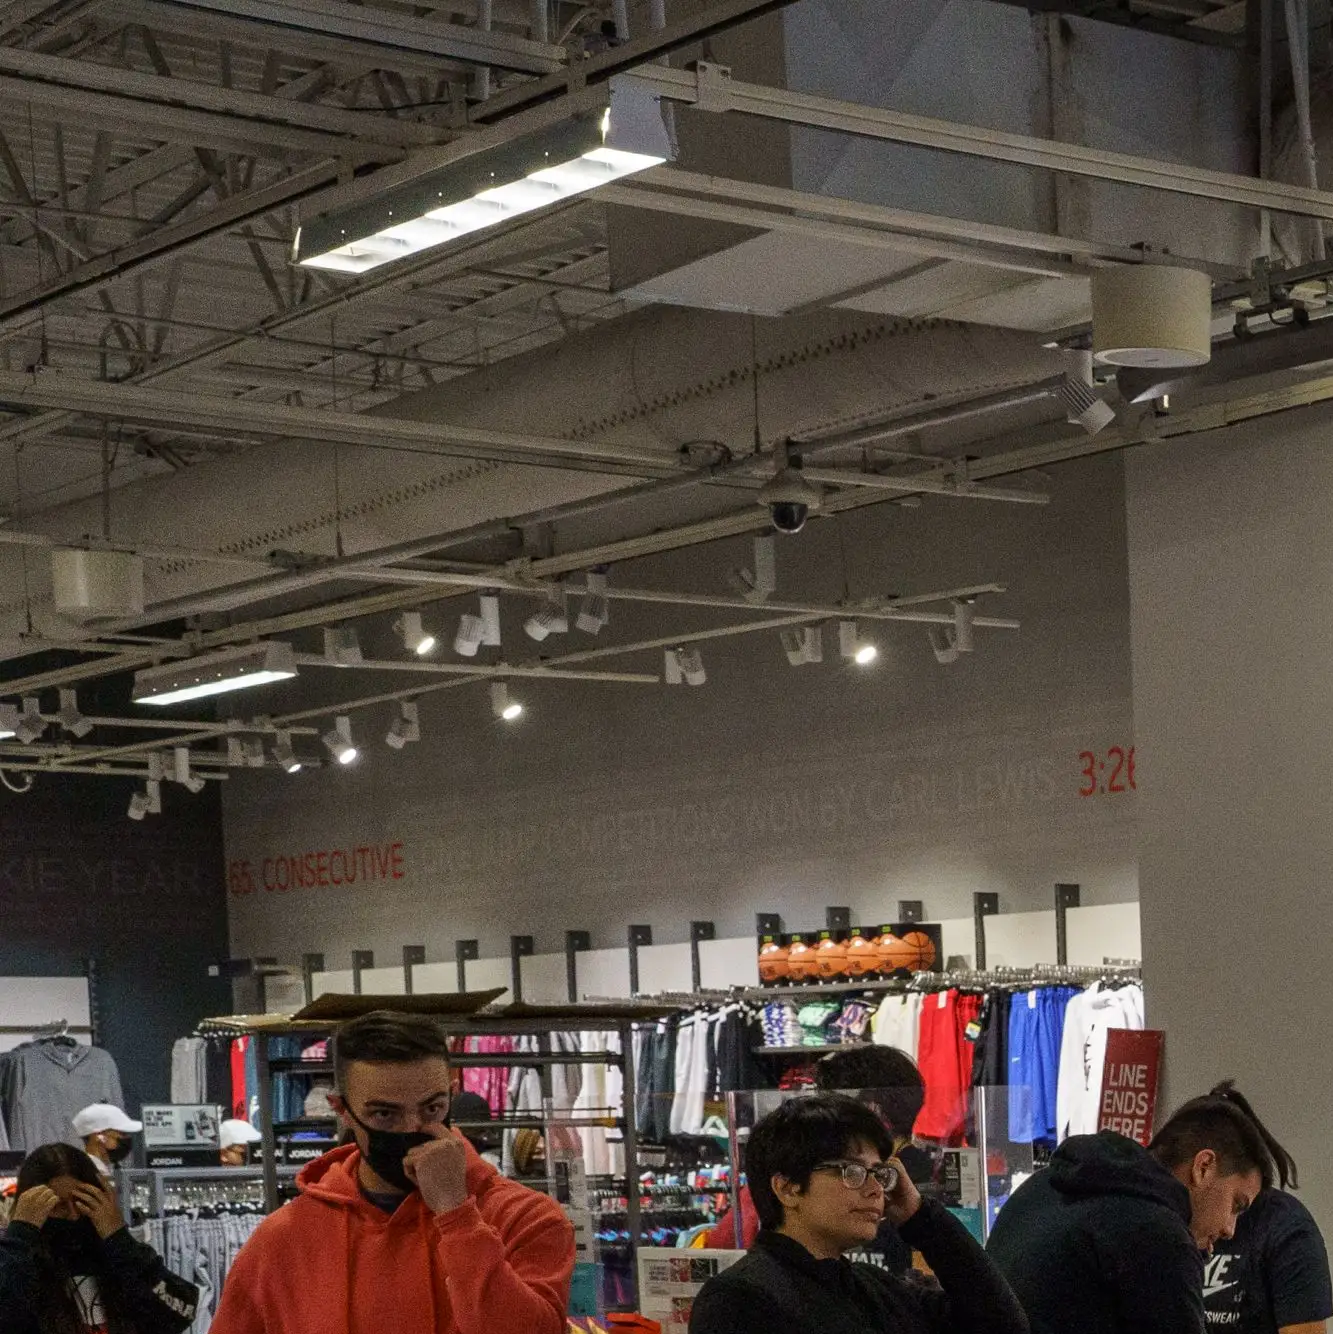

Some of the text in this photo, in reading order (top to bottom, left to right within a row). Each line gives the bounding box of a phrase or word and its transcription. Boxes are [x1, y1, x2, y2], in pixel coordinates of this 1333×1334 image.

[263, 841, 404, 892] CONSECUTIVE
[1109, 1063, 1148, 1088] LINE
[1102, 1090, 1149, 1116] ENDS
[150, 1157, 183, 1166] JORDAN
[288, 1149, 323, 1159] JORDAN
